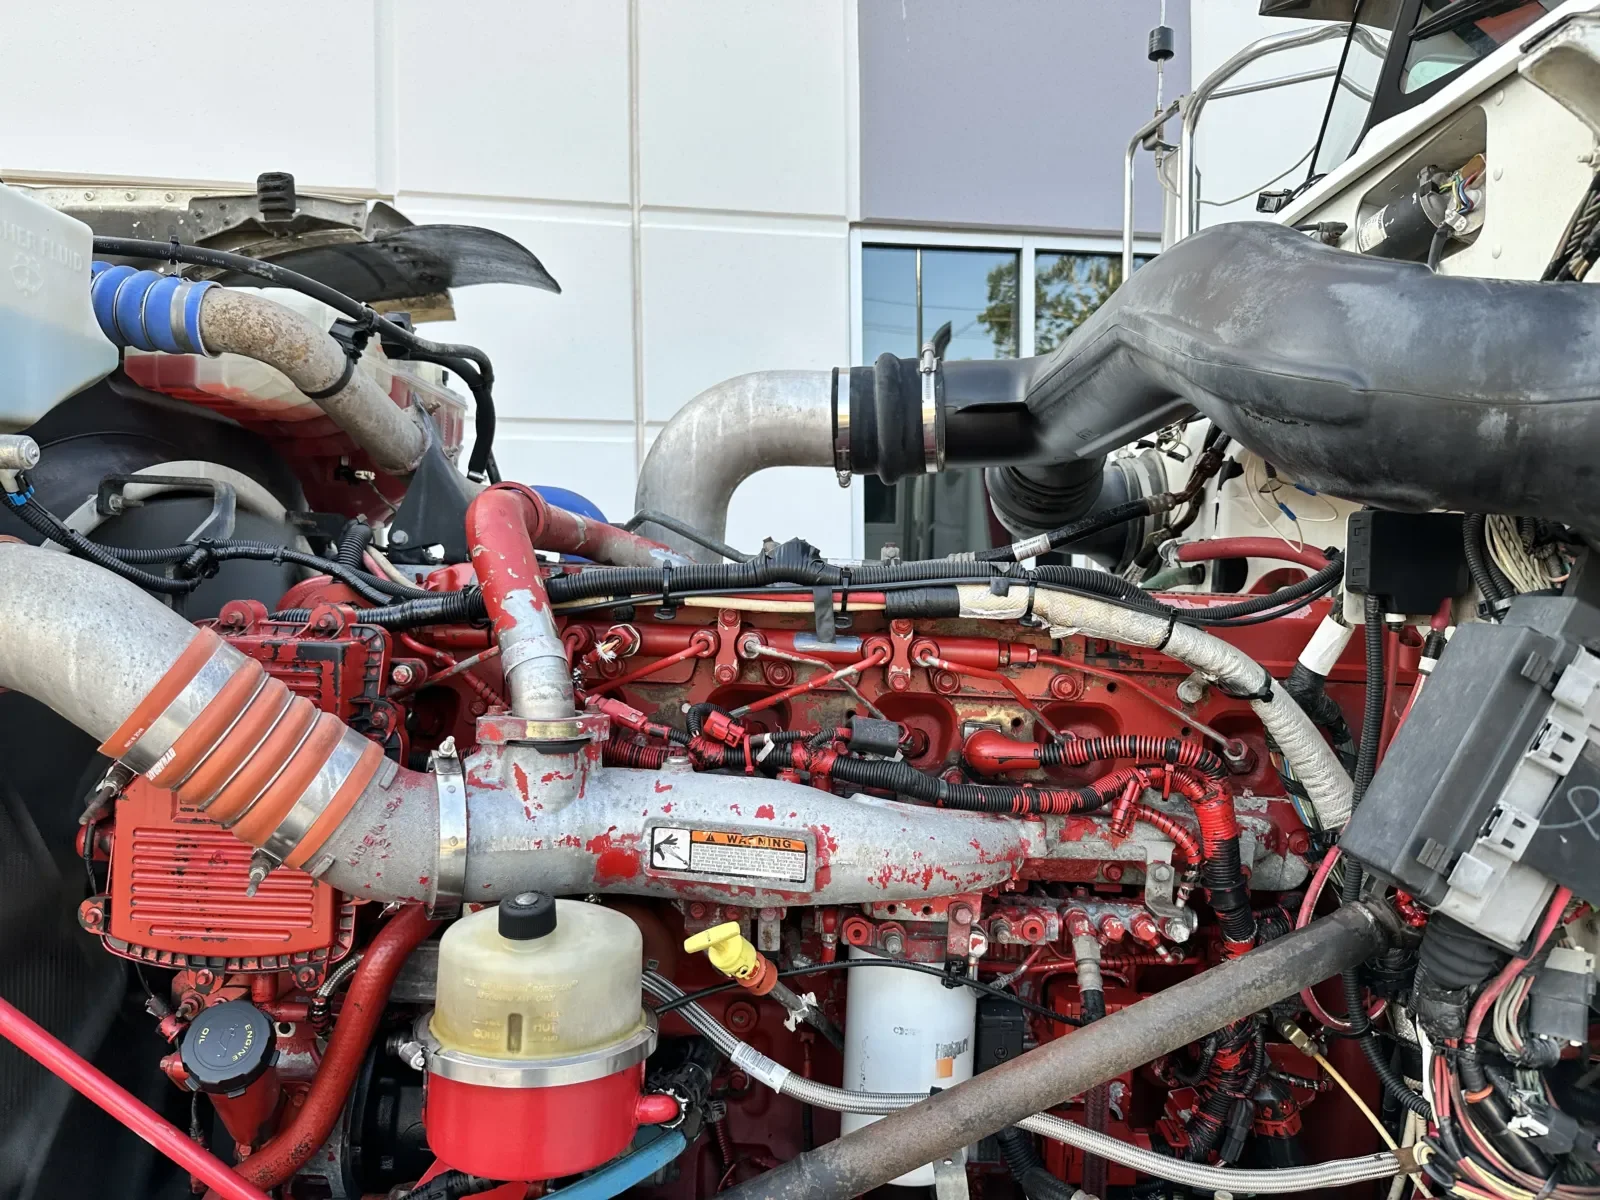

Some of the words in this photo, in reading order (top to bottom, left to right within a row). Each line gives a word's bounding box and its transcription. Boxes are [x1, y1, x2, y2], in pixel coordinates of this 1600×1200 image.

[41, 236, 84, 273] FLUID
[381, 797, 403, 819] USA
[726, 834, 792, 849] WANING
[198, 1027, 210, 1045] OIL
[231, 1023, 253, 1062] ENGINE
